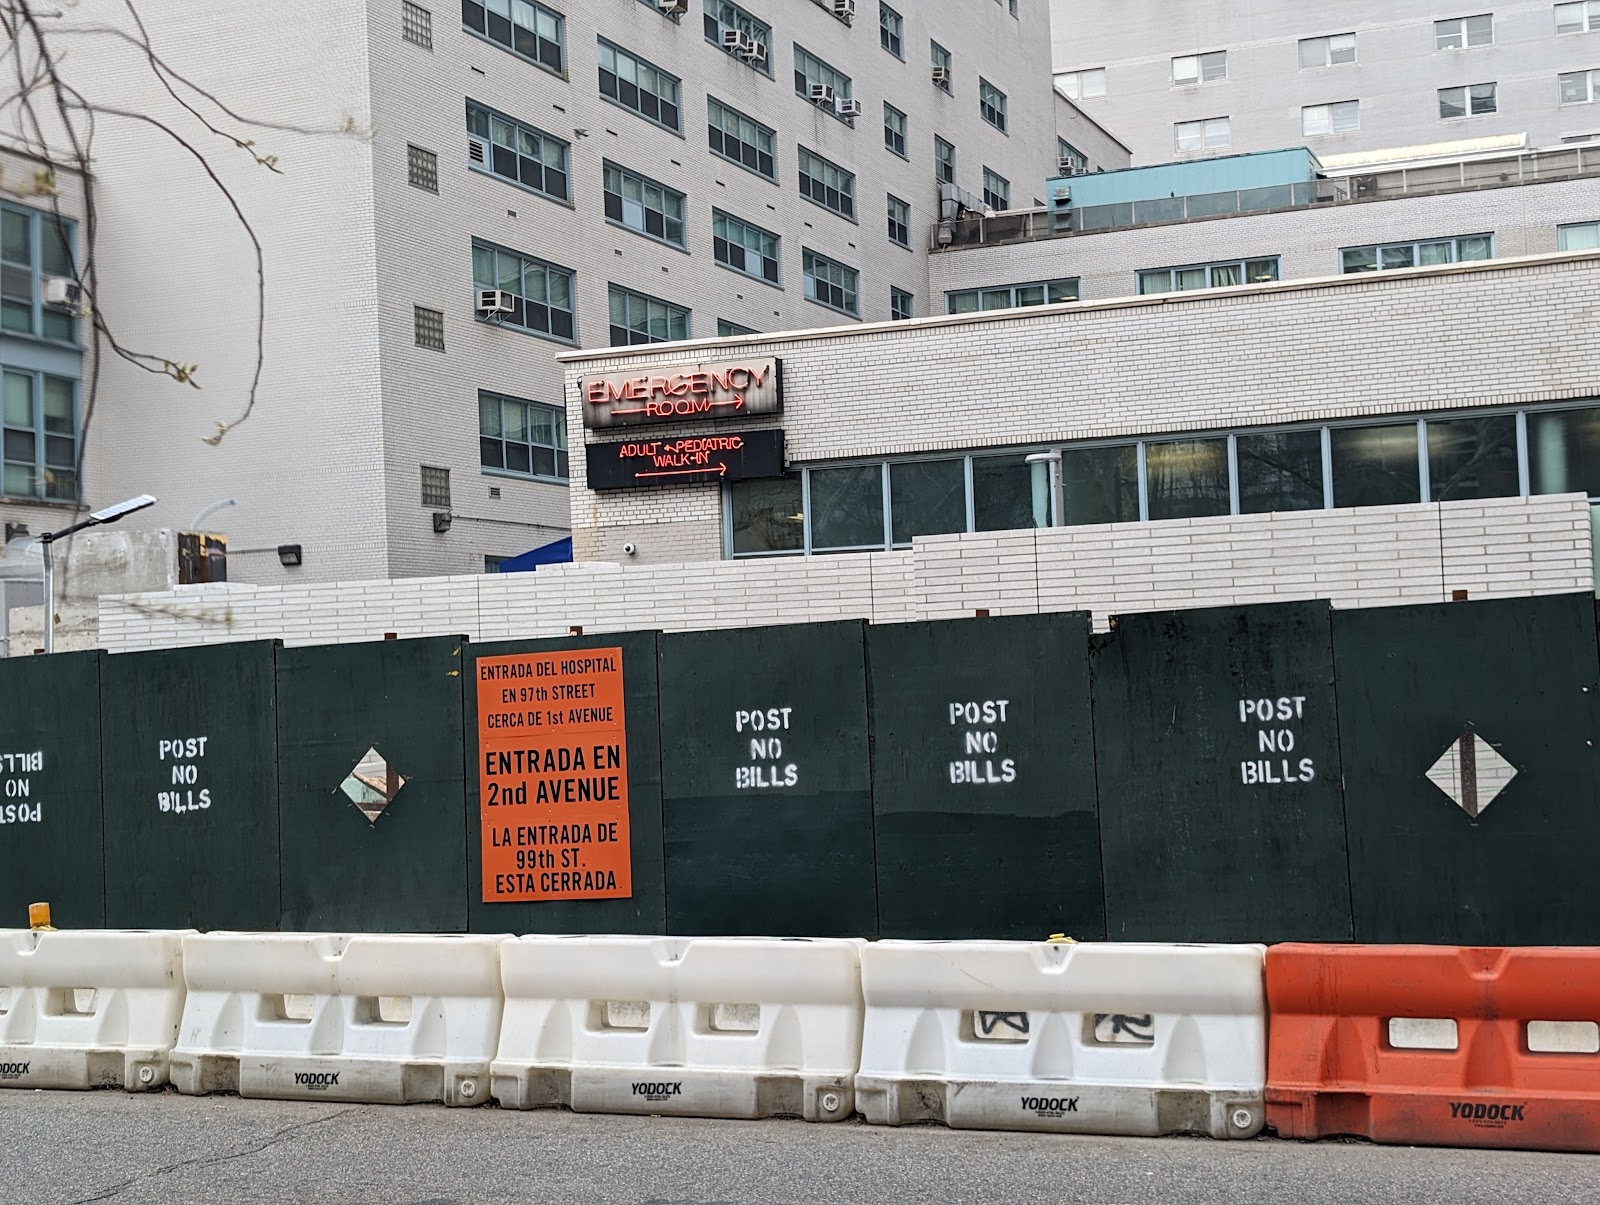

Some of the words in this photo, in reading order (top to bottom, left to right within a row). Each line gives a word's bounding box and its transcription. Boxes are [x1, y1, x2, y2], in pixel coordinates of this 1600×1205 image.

[588, 365, 769, 402] EMERGENCY
[646, 398, 710, 417] ROOM
[620, 442, 662, 458] ADULT
[653, 451, 710, 467] WALK-IN
[481, 663, 533, 680] ENTRADA
[537, 662, 557, 677] DEL
[561, 657, 616, 675] HOSPITAL
[502, 689, 516, 703] EN
[520, 687, 548, 702] 97th
[552, 683, 595, 700] STREET
[488, 712, 524, 728] CERCA
[528, 711, 542, 726] DE
[547, 710, 564, 725] 1st
[568, 707, 613, 724] AVENUE
[736, 708, 792, 732] POST
[949, 700, 1009, 725] POST
[1239, 696, 1306, 722] POST
[160, 737, 207, 760] POST
[750, 738, 782, 760] NO
[966, 731, 997, 754] NO
[1259, 729, 1294, 752] NO
[486, 747, 586, 775] ENTRADA
[594, 745, 620, 769] EN
[949, 758, 1017, 784] BILLS
[1241, 757, 1315, 784] BILLS
[172, 765, 197, 785] NO
[736, 763, 798, 788] BILLS
[5, 778, 29, 797] NO
[488, 781, 527, 806] 2nd
[536, 776, 620, 804] AVENUE
[158, 789, 211, 814] BILLS
[493, 828, 511, 847] LA
[518, 824, 592, 846] ENTRADA
[598, 822, 618, 842] DE
[516, 850, 555, 869] 99th
[561, 848, 586, 868] ST.
[496, 873, 536, 894] ESTA
[541, 870, 617, 892] CERRADA
[295, 1072, 339, 1085] YODOCK
[632, 1082, 682, 1095] YODOCK
[1021, 1097, 1078, 1111] YODOCK
[1449, 1102, 1525, 1120] YODOCK
